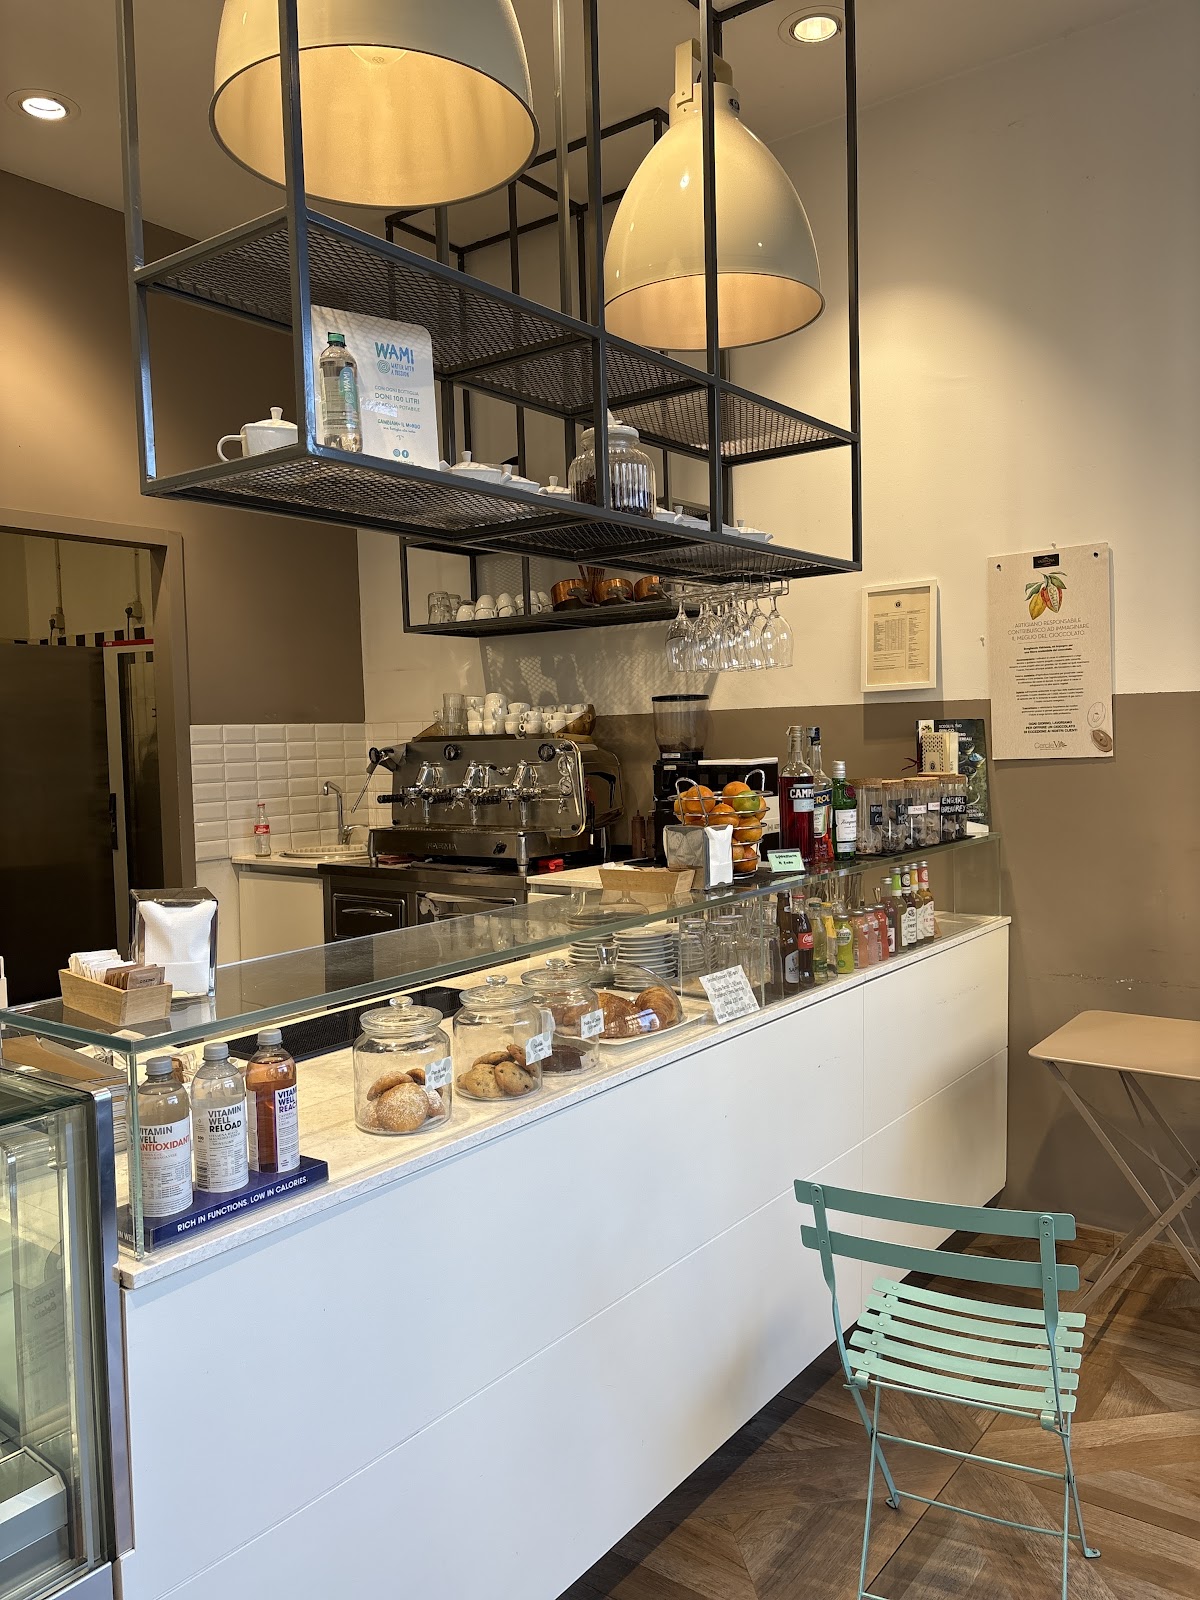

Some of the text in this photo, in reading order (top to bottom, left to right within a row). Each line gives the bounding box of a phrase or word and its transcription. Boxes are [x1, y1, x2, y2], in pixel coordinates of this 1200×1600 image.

[375, 342, 414, 364] WAMI
[375, 392, 392, 400] DONI
[789, 788, 814, 798] CAMPA
[814, 794, 830, 804] EROL
[278, 1086, 298, 1099] VITAM
[278, 1096, 295, 1106] WELL
[279, 1101, 296, 1114] REAC
[208, 1105, 242, 1118] VITAMIN
[209, 1116, 231, 1126] WELL
[210, 1120, 242, 1133] RELOAD
[177, 1176, 309, 1232] RICH IN FUNCTIONS. LOW IN CALORIES.
